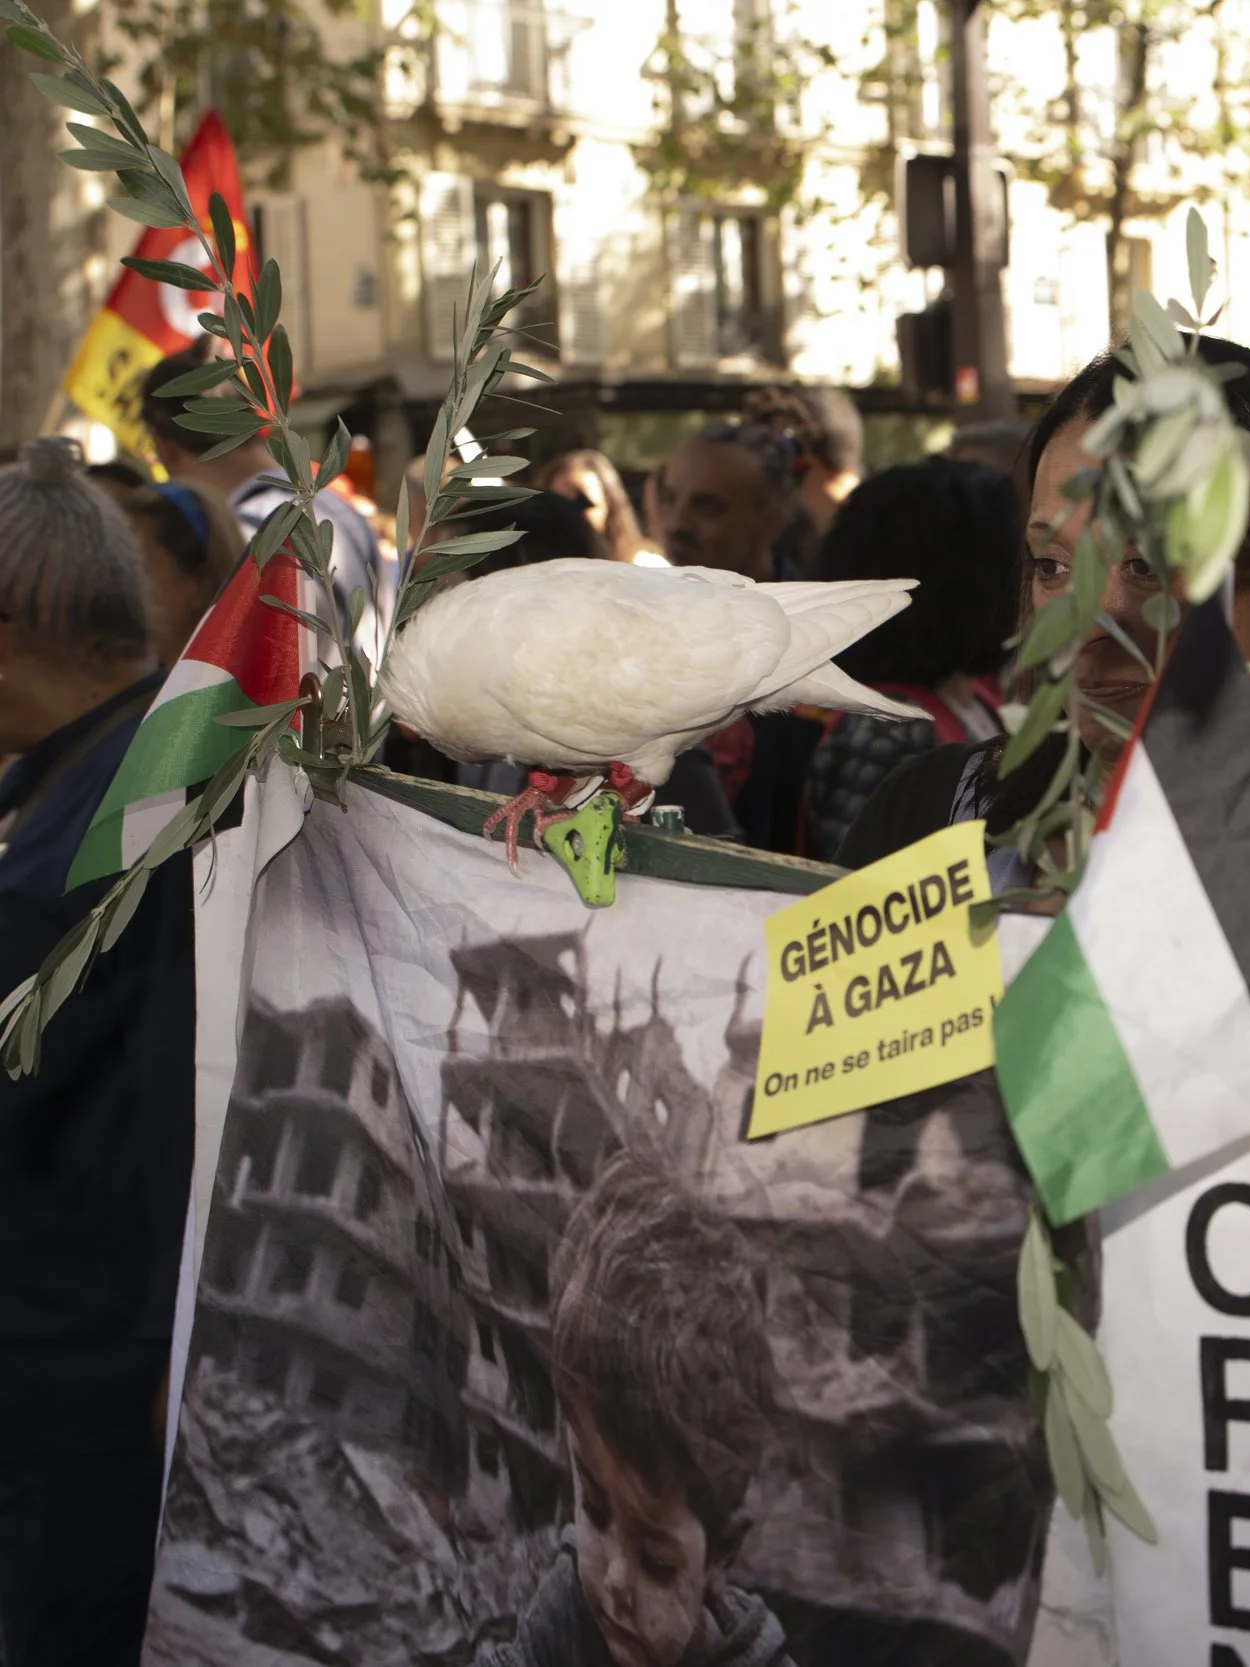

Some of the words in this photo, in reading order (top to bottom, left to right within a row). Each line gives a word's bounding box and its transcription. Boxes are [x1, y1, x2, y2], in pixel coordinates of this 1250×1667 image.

[780, 859, 974, 983] GÉNOCIDE
[805, 983, 834, 1035] À
[844, 940, 956, 1018] GAZA
[764, 1072, 798, 1097] On
[805, 1061, 835, 1086] ne
[842, 1051, 870, 1074] se
[877, 1027, 933, 1062] taira
[941, 1007, 984, 1046] pas
